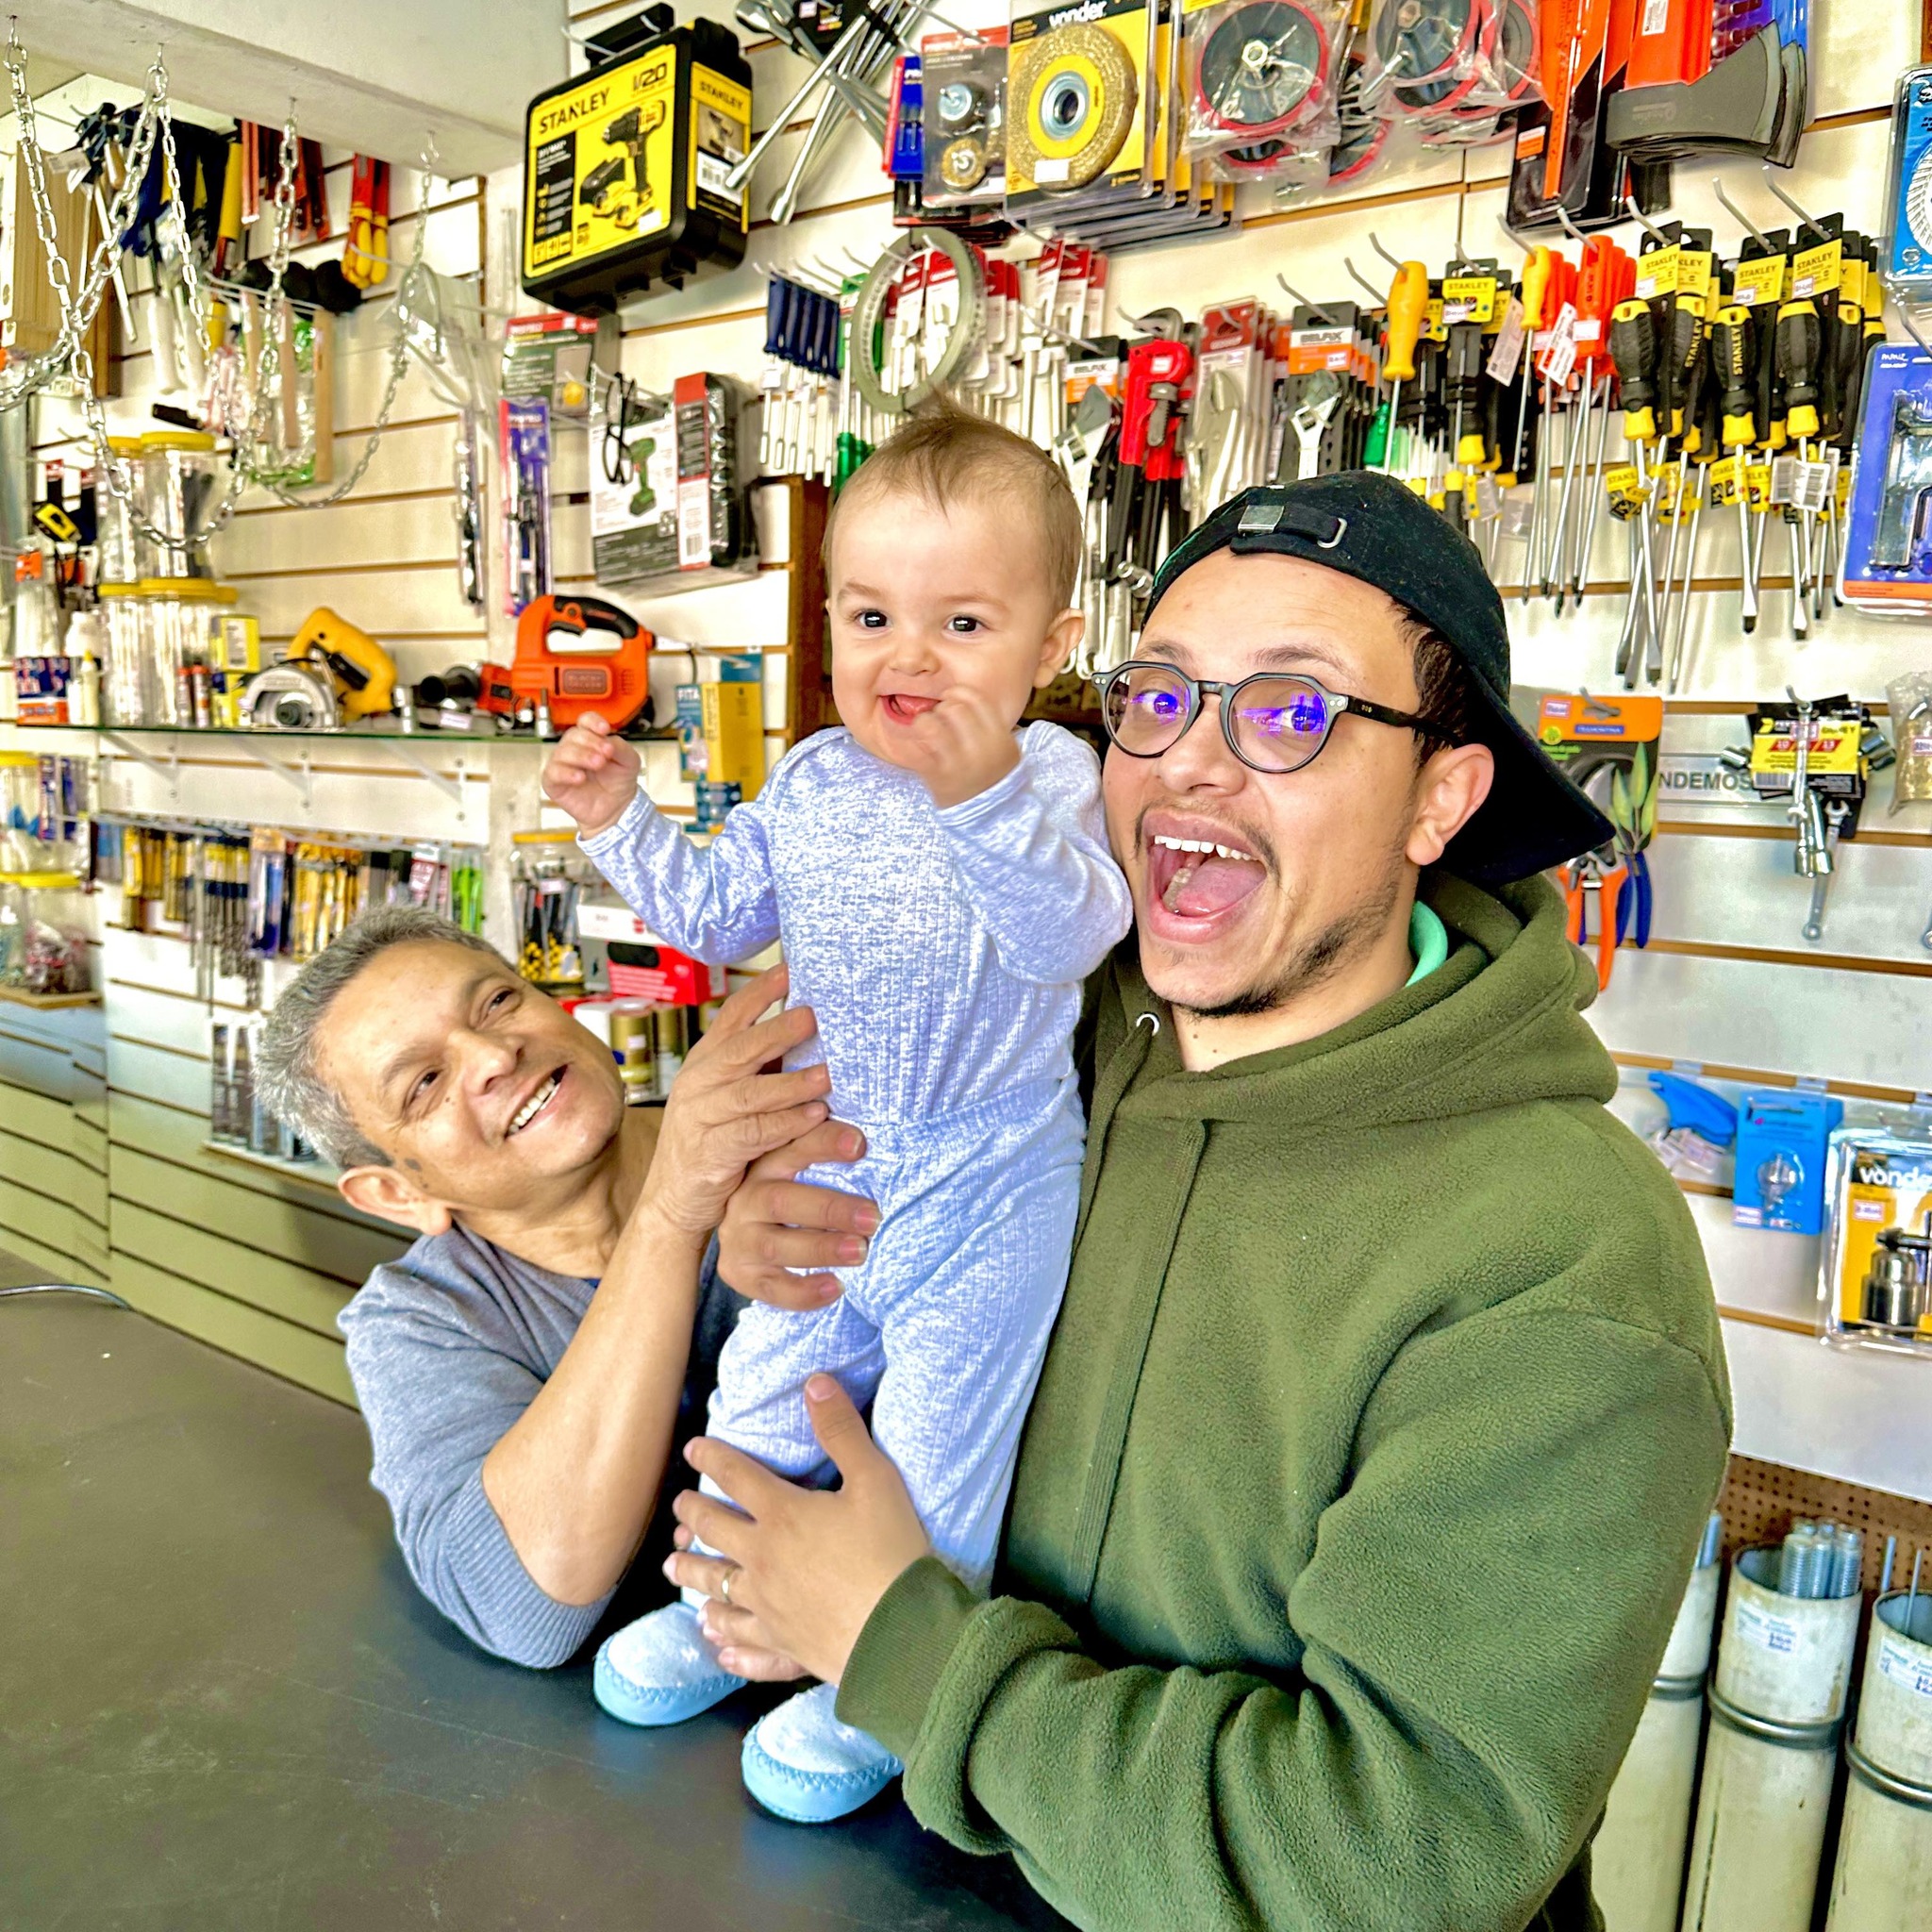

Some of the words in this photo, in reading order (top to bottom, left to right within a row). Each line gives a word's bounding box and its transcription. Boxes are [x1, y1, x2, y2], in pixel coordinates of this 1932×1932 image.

[699, 81, 745, 110] STANLEY
[539, 87, 610, 136] STANLEY
[1645, 253, 1678, 270] STANLEY
[1739, 264, 1777, 279] STANLEY
[1796, 250, 1833, 271] STANLEY
[1448, 281, 1490, 291] STANLEY
[1684, 318, 1703, 368] STANLEY
[1731, 327, 1743, 375] STANLEY
